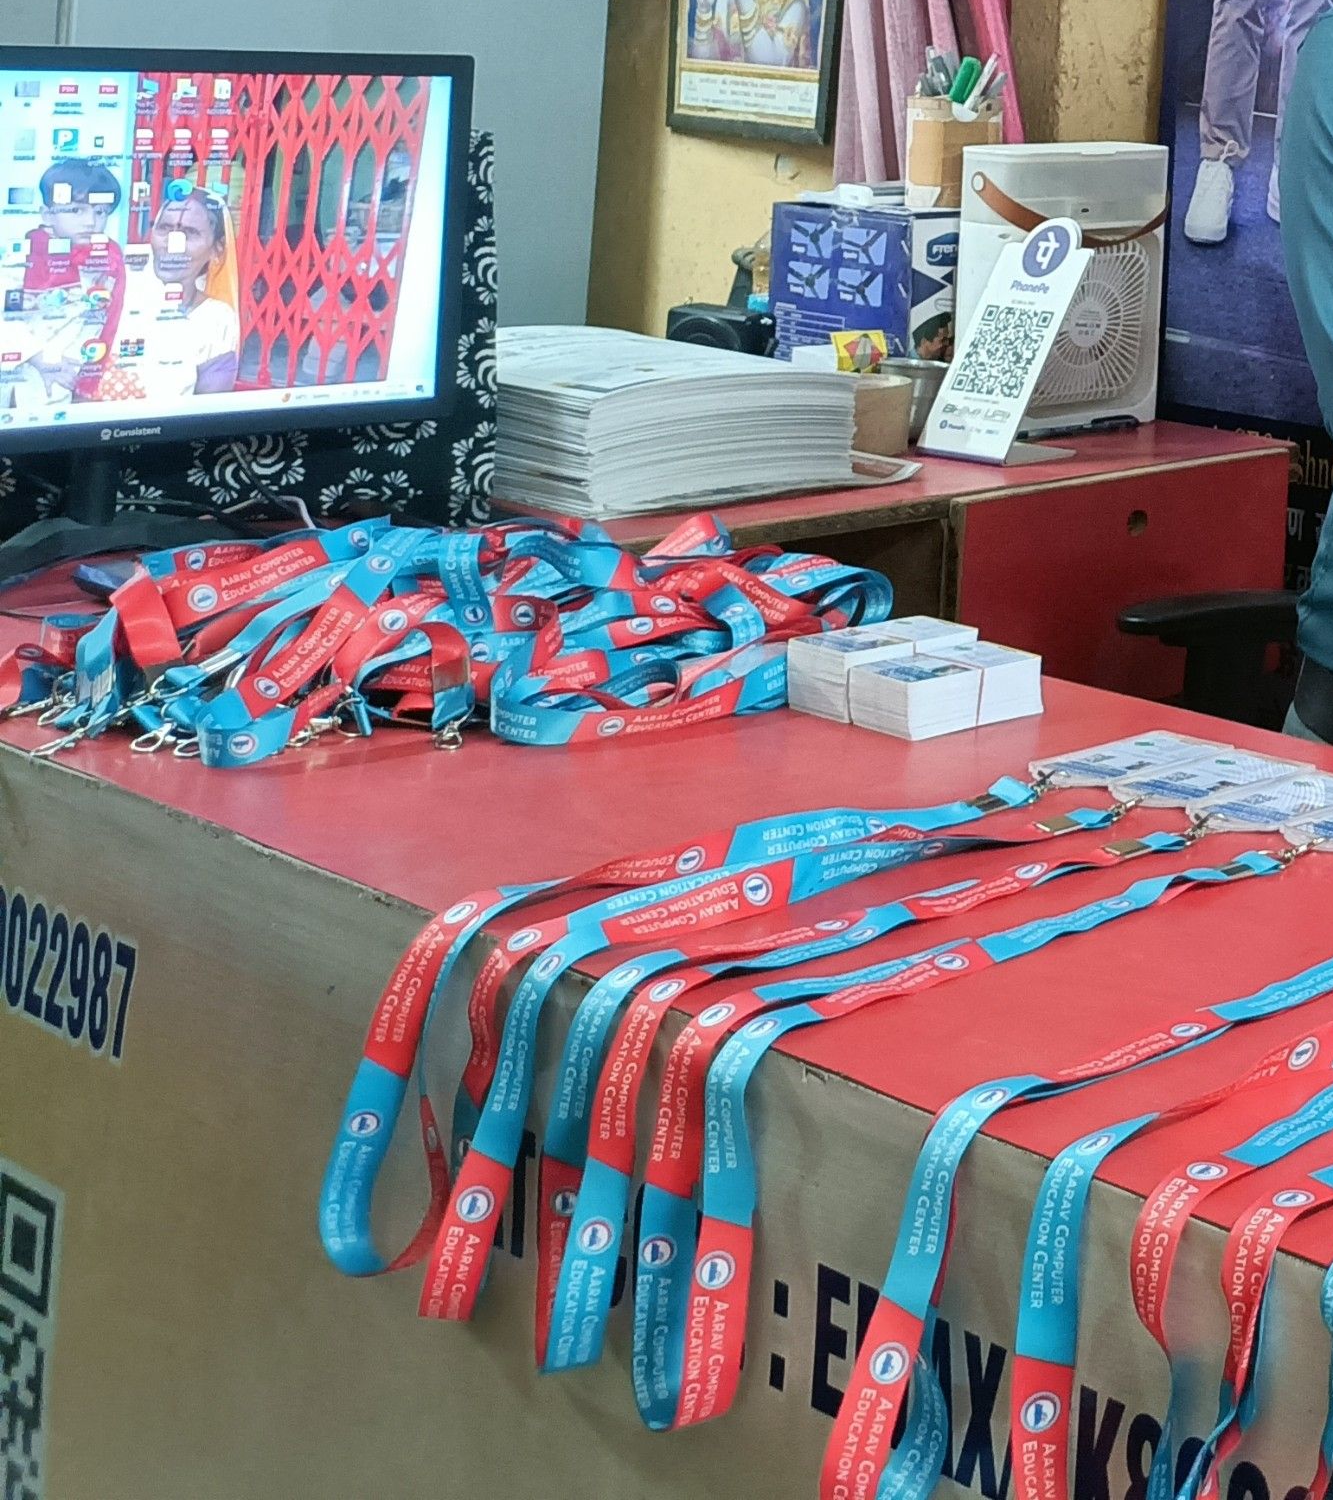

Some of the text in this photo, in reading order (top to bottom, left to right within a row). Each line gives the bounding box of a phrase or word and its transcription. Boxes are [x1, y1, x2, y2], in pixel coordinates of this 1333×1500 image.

[1010, 280, 1050, 294] PhonePe
[113, 426, 161, 437] Consistent
[907, 1110, 969, 1256] EDUCATION CENTER
[925, 1116, 977, 1254] AARAV COMPUTER
[1030, 1158, 1074, 1309] EDUCATION CENTER
[1051, 1164, 1084, 1305] AARAV COMPUTER
